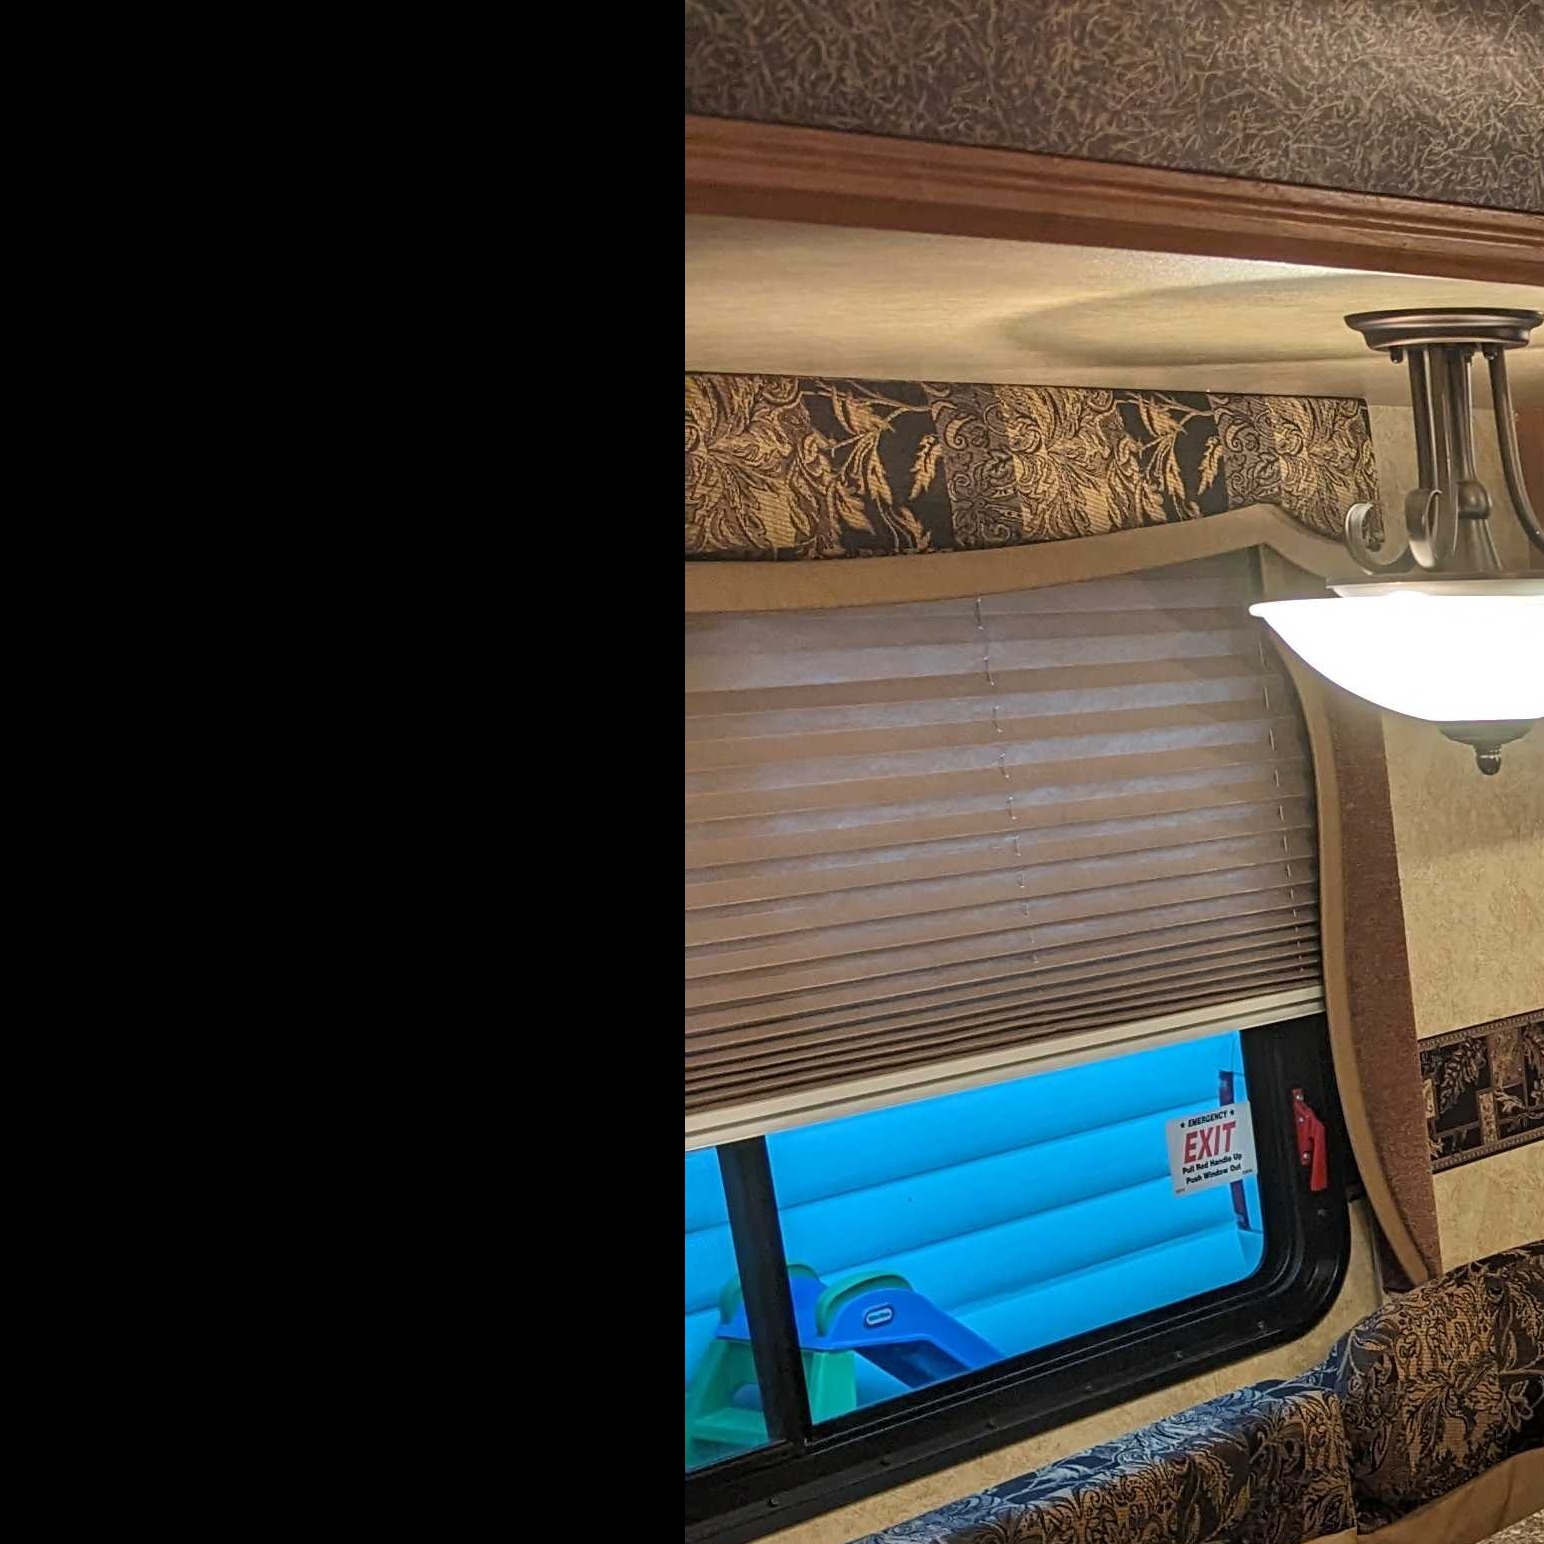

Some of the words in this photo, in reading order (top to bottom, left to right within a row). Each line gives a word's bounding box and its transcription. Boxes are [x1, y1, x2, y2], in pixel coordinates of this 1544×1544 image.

[1187, 1109, 1228, 1127] EMERGENCY
[1183, 1120, 1237, 1164] EXIT
[1182, 1165, 1195, 1175] Pull
[1196, 1161, 1209, 1171] Red
[1209, 1155, 1232, 1166] Handle
[1232, 1152, 1243, 1161] Up
[1186, 1174, 1203, 1184] Push
[1203, 1168, 1229, 1179] Window
[1229, 1163, 1242, 1172] Out
